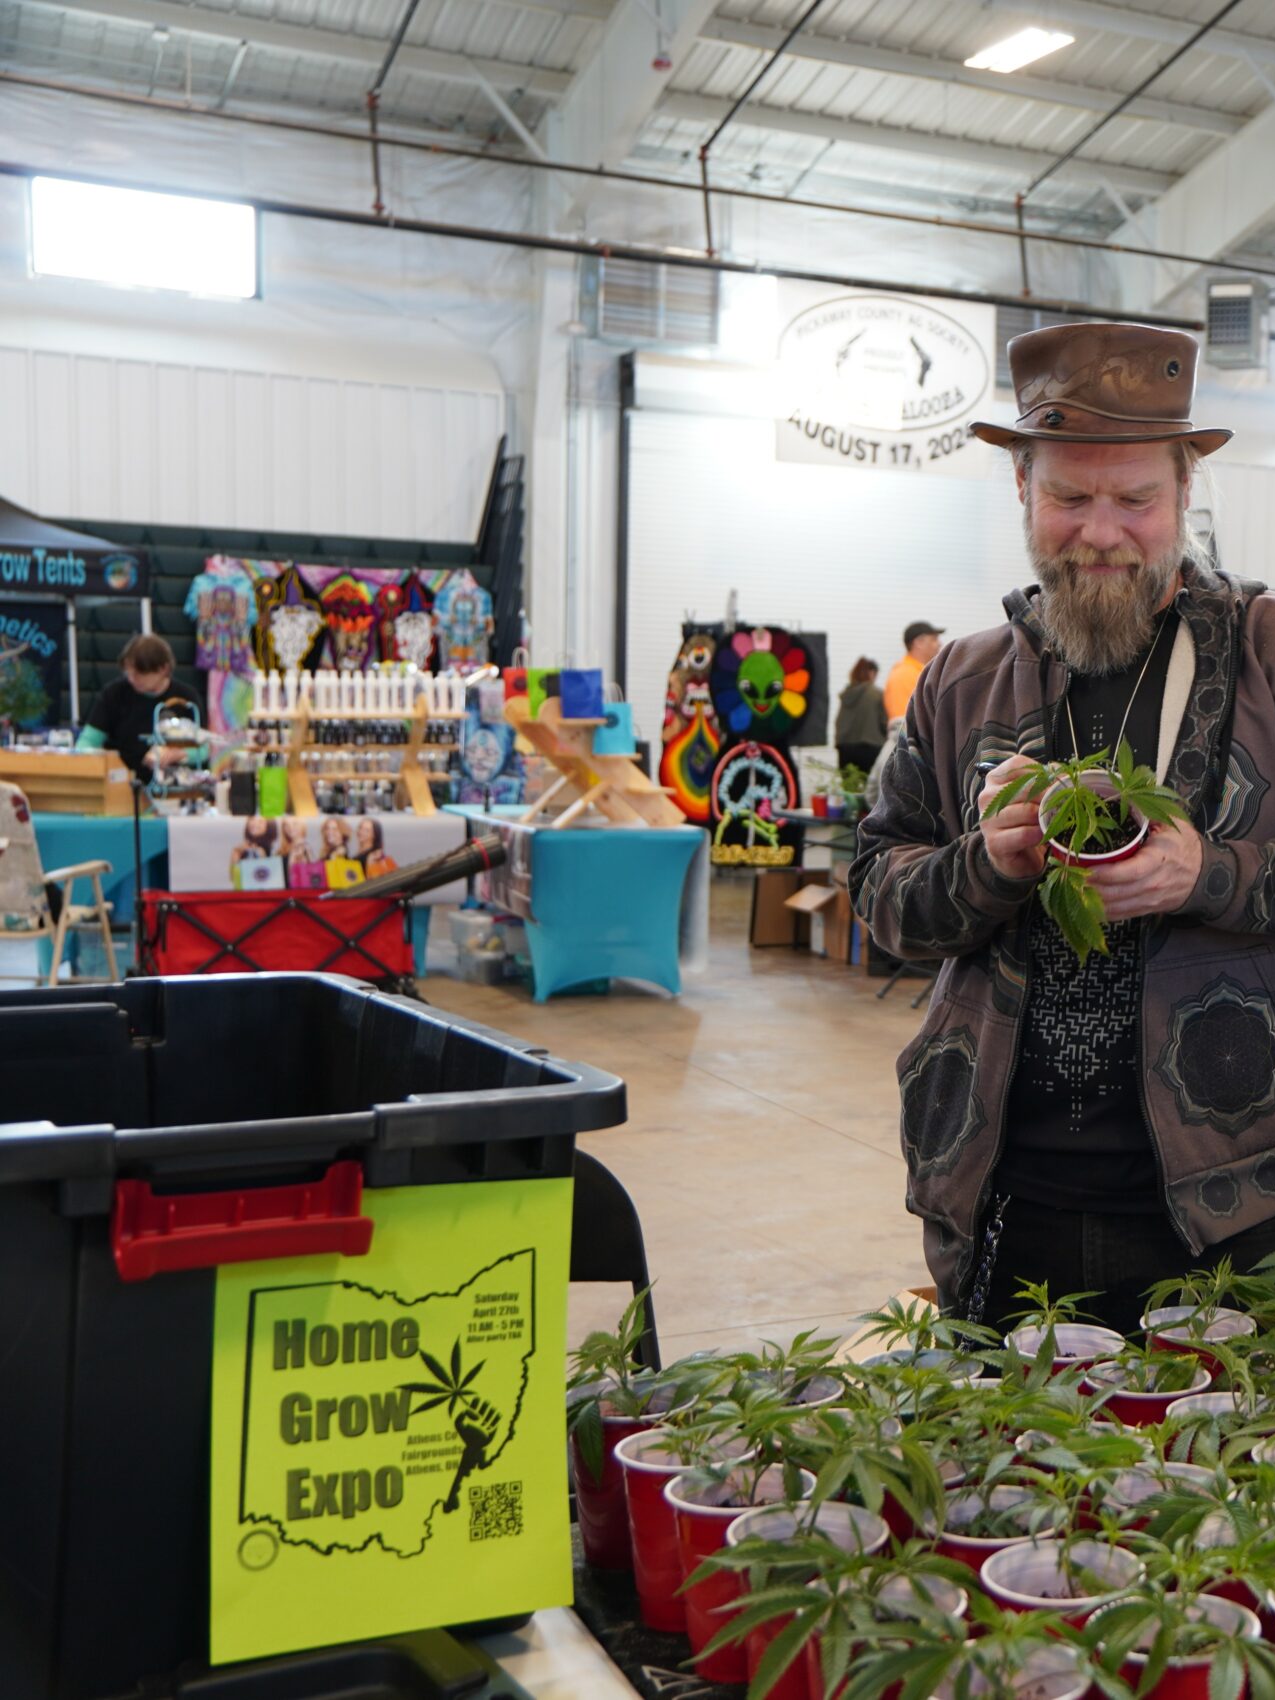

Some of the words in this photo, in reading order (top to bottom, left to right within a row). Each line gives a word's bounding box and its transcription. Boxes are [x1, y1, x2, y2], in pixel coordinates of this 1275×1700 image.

[857, 306, 902, 324] COUNTY
[907, 313, 923, 329] AG
[927, 319, 970, 355] SOCIETY
[787, 407, 880, 464] AUGUST
[890, 444, 923, 468] 17,
[32, 547, 87, 587] Tents
[473, 1307, 497, 1318] April
[498, 1305, 519, 1316] 27th
[474, 1291, 519, 1304] Saturday
[467, 1322, 477, 1333] 11
[478, 1321, 494, 1332] AM
[501, 1319, 508, 1331] 5
[509, 1318, 524, 1329] PM
[486, 1333, 507, 1342] party
[273, 1316, 420, 1371] Home
[280, 1390, 413, 1446] Grow
[402, 1445, 463, 1461] Fairgrounds
[407, 1433, 442, 1446] Athens
[286, 1464, 405, 1521] Expo
